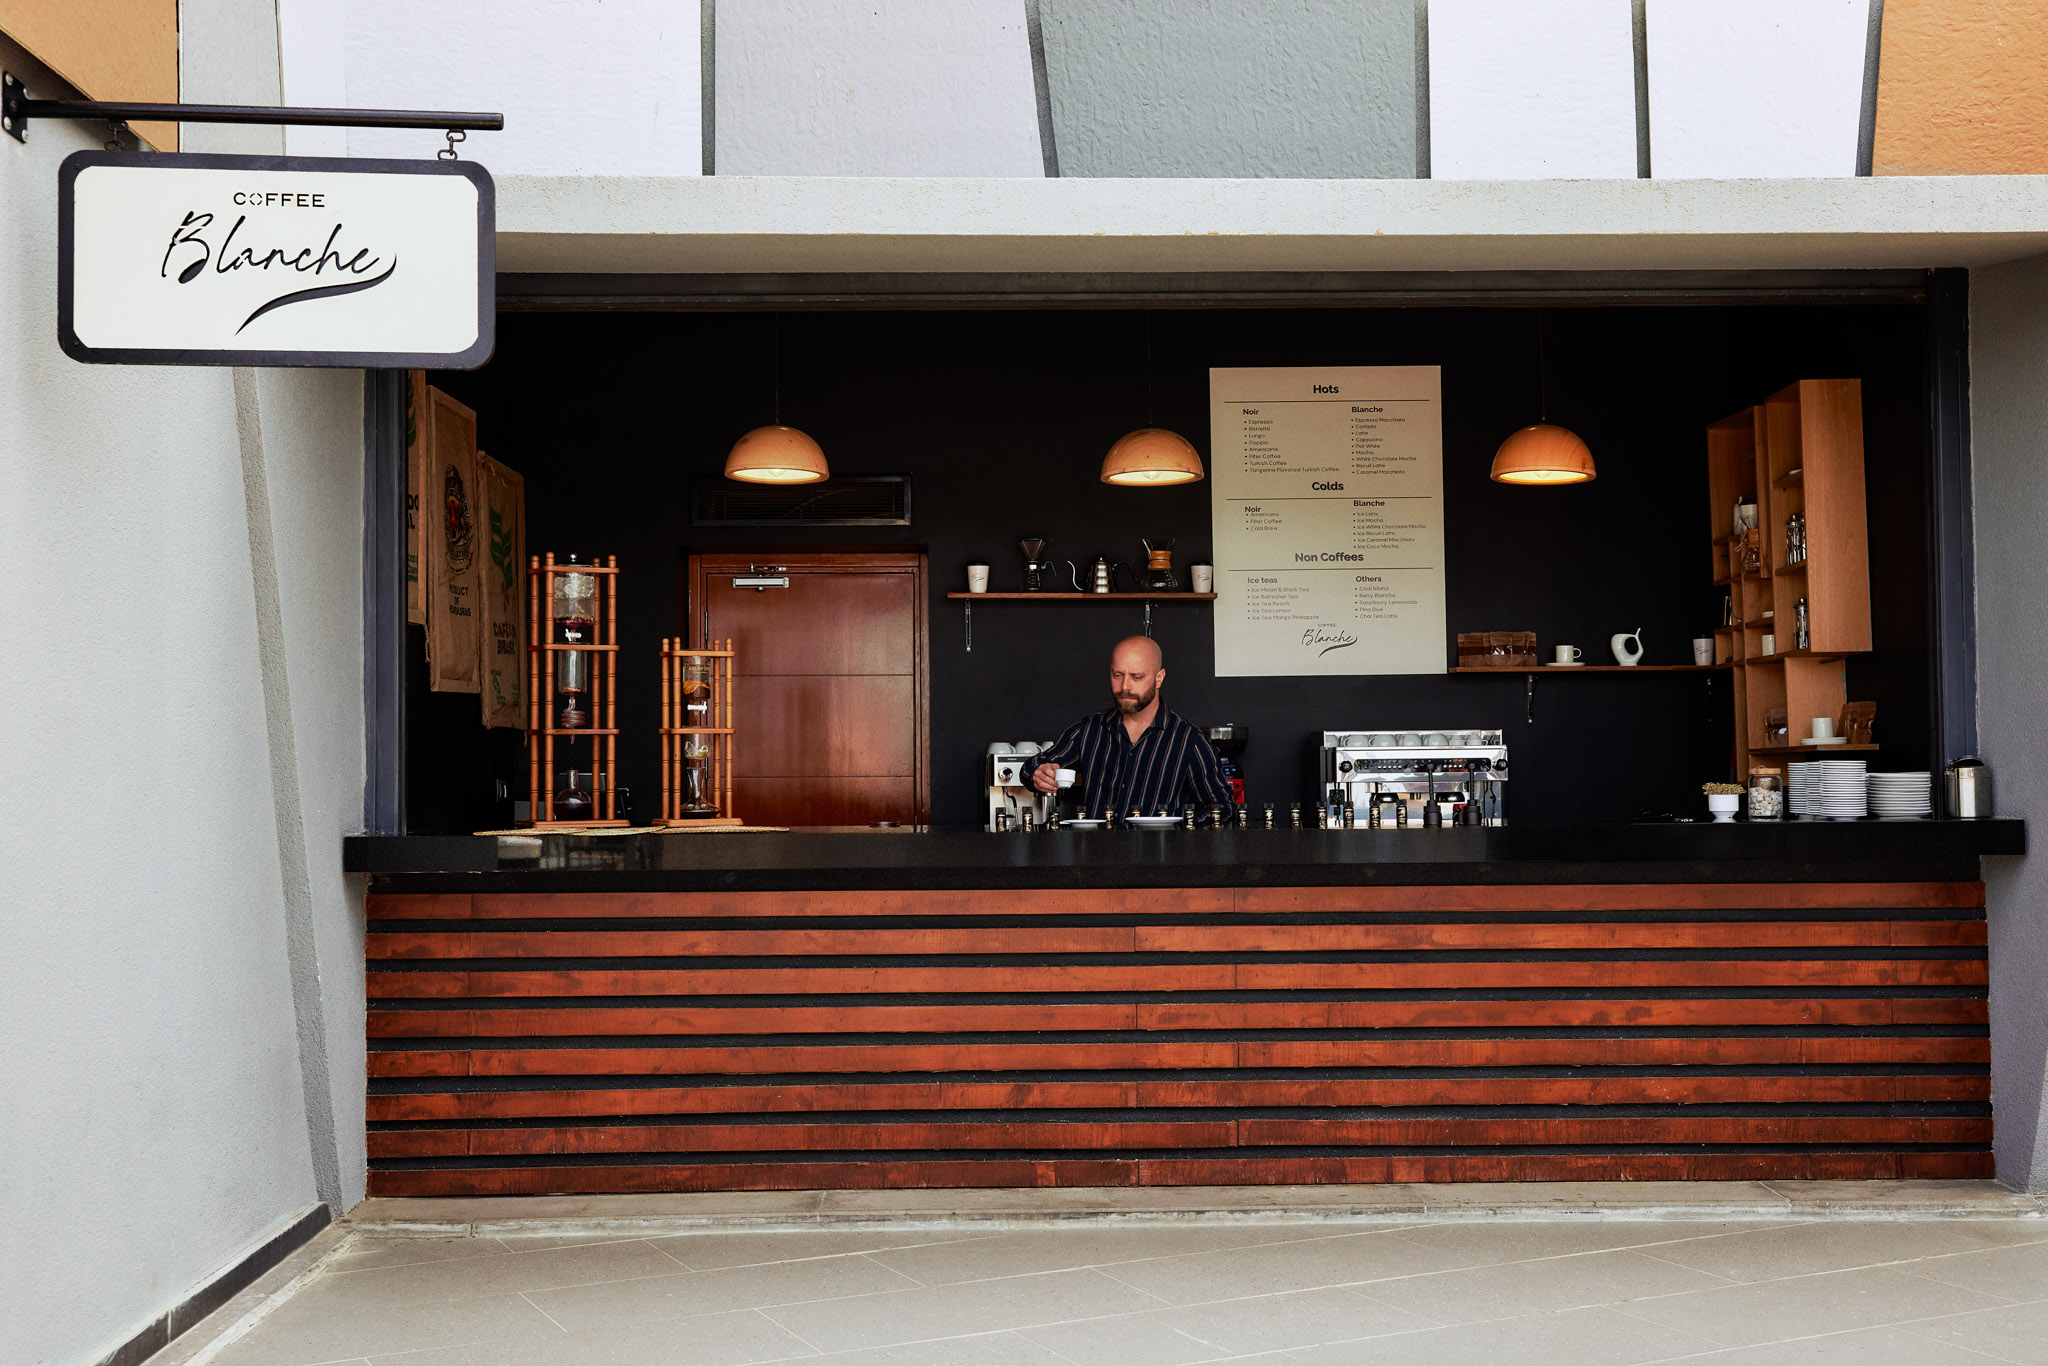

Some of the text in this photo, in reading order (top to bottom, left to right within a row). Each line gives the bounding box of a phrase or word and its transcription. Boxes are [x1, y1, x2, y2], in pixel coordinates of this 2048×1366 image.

[233, 191, 326, 208] COFFEE
[161, 211, 392, 298] Blanche
[1313, 384, 1339, 394] Hots
[1312, 482, 1344, 491] Colds
[1295, 552, 1364, 562] Non Coffees
[1302, 628, 1356, 649] Blanche
